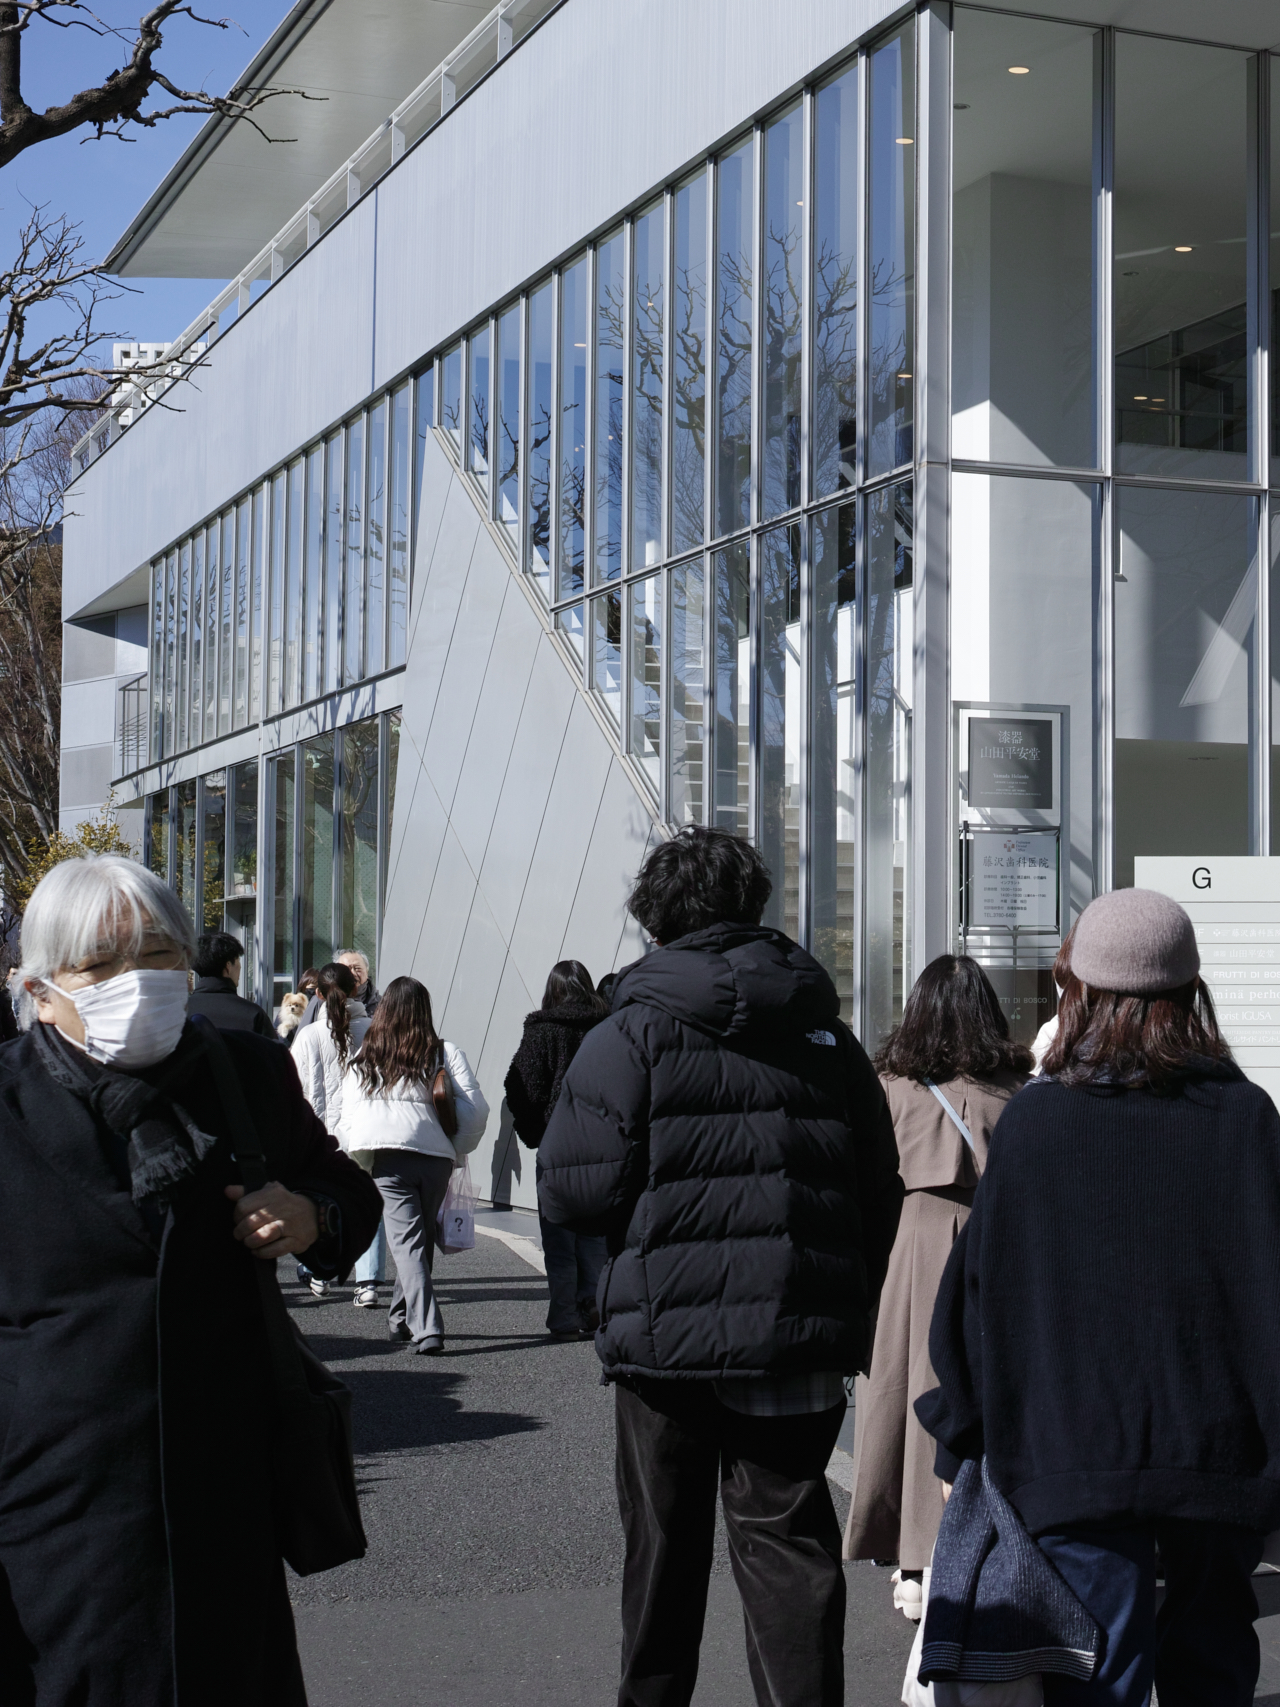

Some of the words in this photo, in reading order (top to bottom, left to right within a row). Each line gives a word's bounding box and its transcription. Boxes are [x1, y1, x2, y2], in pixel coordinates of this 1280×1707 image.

[998, 730, 1023, 744] 漆器
[980, 746, 1041, 760] 山田平安堂
[983, 855, 1050, 869] 藤沢歯科医院
[1192, 867, 1212, 889] G
[1213, 990, 1244, 999] minä
[1218, 1010, 1239, 1020] lorist
[1241, 1010, 1272, 1020] IGUSA
